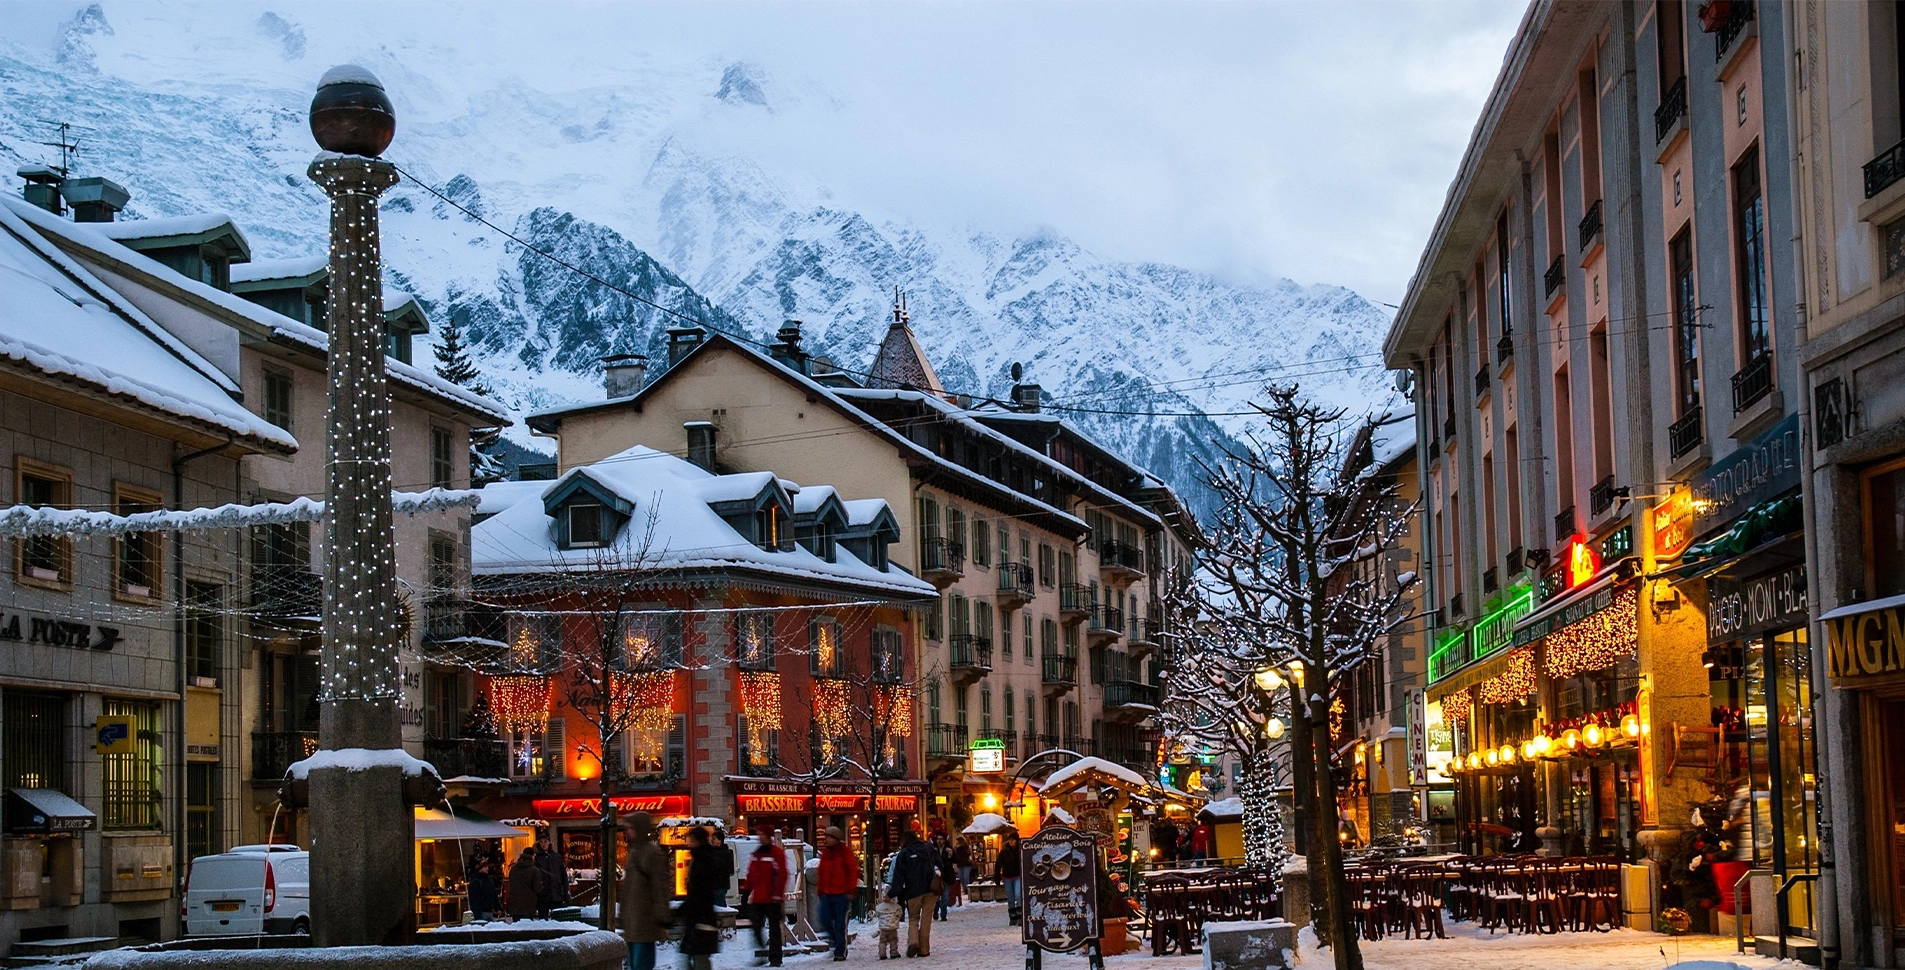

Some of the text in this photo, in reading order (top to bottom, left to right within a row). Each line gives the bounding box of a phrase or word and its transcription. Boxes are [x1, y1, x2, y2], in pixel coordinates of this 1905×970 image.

[1709, 592, 1742, 638] PHOTO
[1747, 577, 1777, 626] MONT
[30, 617, 90, 648] POSTE
[401, 702, 424, 727] uides
[1413, 693, 1424, 781] CINEMA
[768, 784, 798, 792] BRASSERIE
[556, 801, 572, 813] le
[746, 796, 915, 812] BRASSERIE National RSTAURANT
[64, 820, 83, 829] POSTE
[1042, 832, 1073, 840] Atelier
